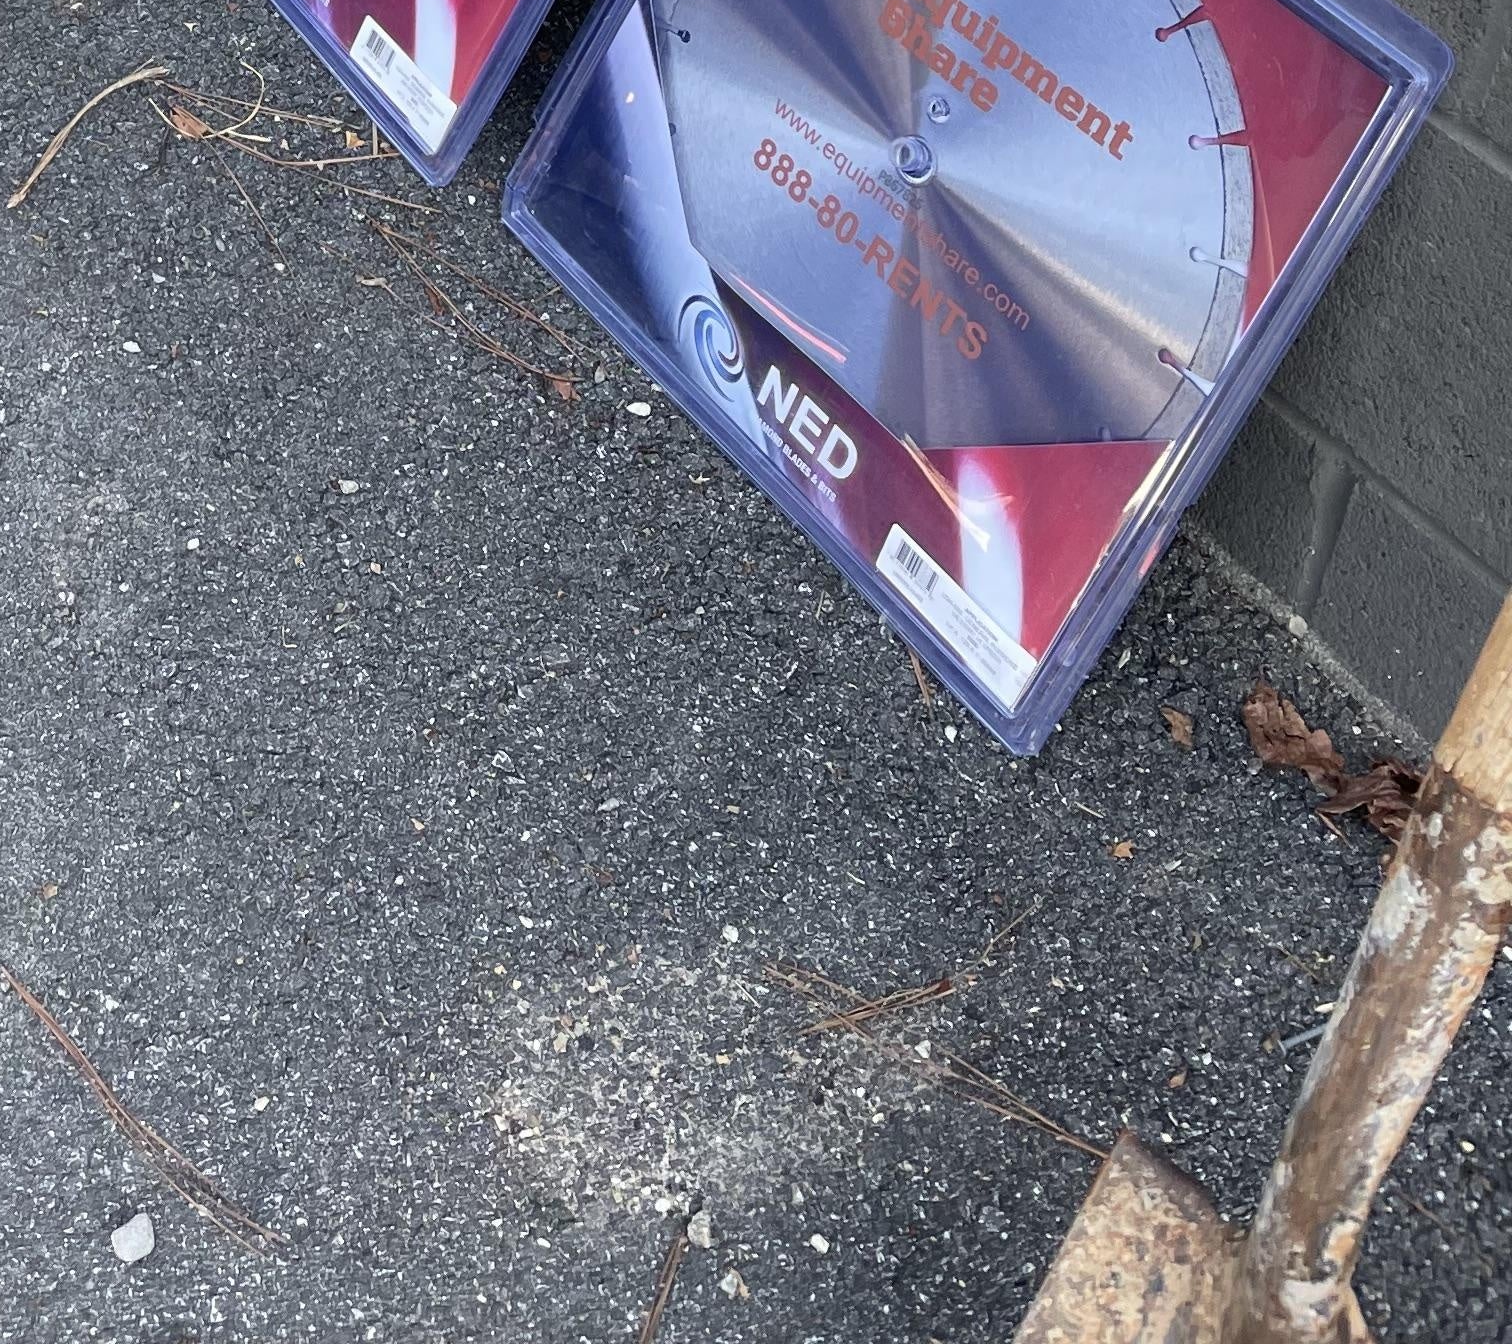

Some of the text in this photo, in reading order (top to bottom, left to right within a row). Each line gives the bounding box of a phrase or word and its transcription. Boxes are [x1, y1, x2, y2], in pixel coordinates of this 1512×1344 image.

[753, 138, 988, 360] 888-80-RENTS
[774, 98, 1031, 331] www.equipmenhare.com
[757, 364, 858, 479] NED
[782, 444, 812, 477] BLADES
[817, 480, 837, 503] BITS
